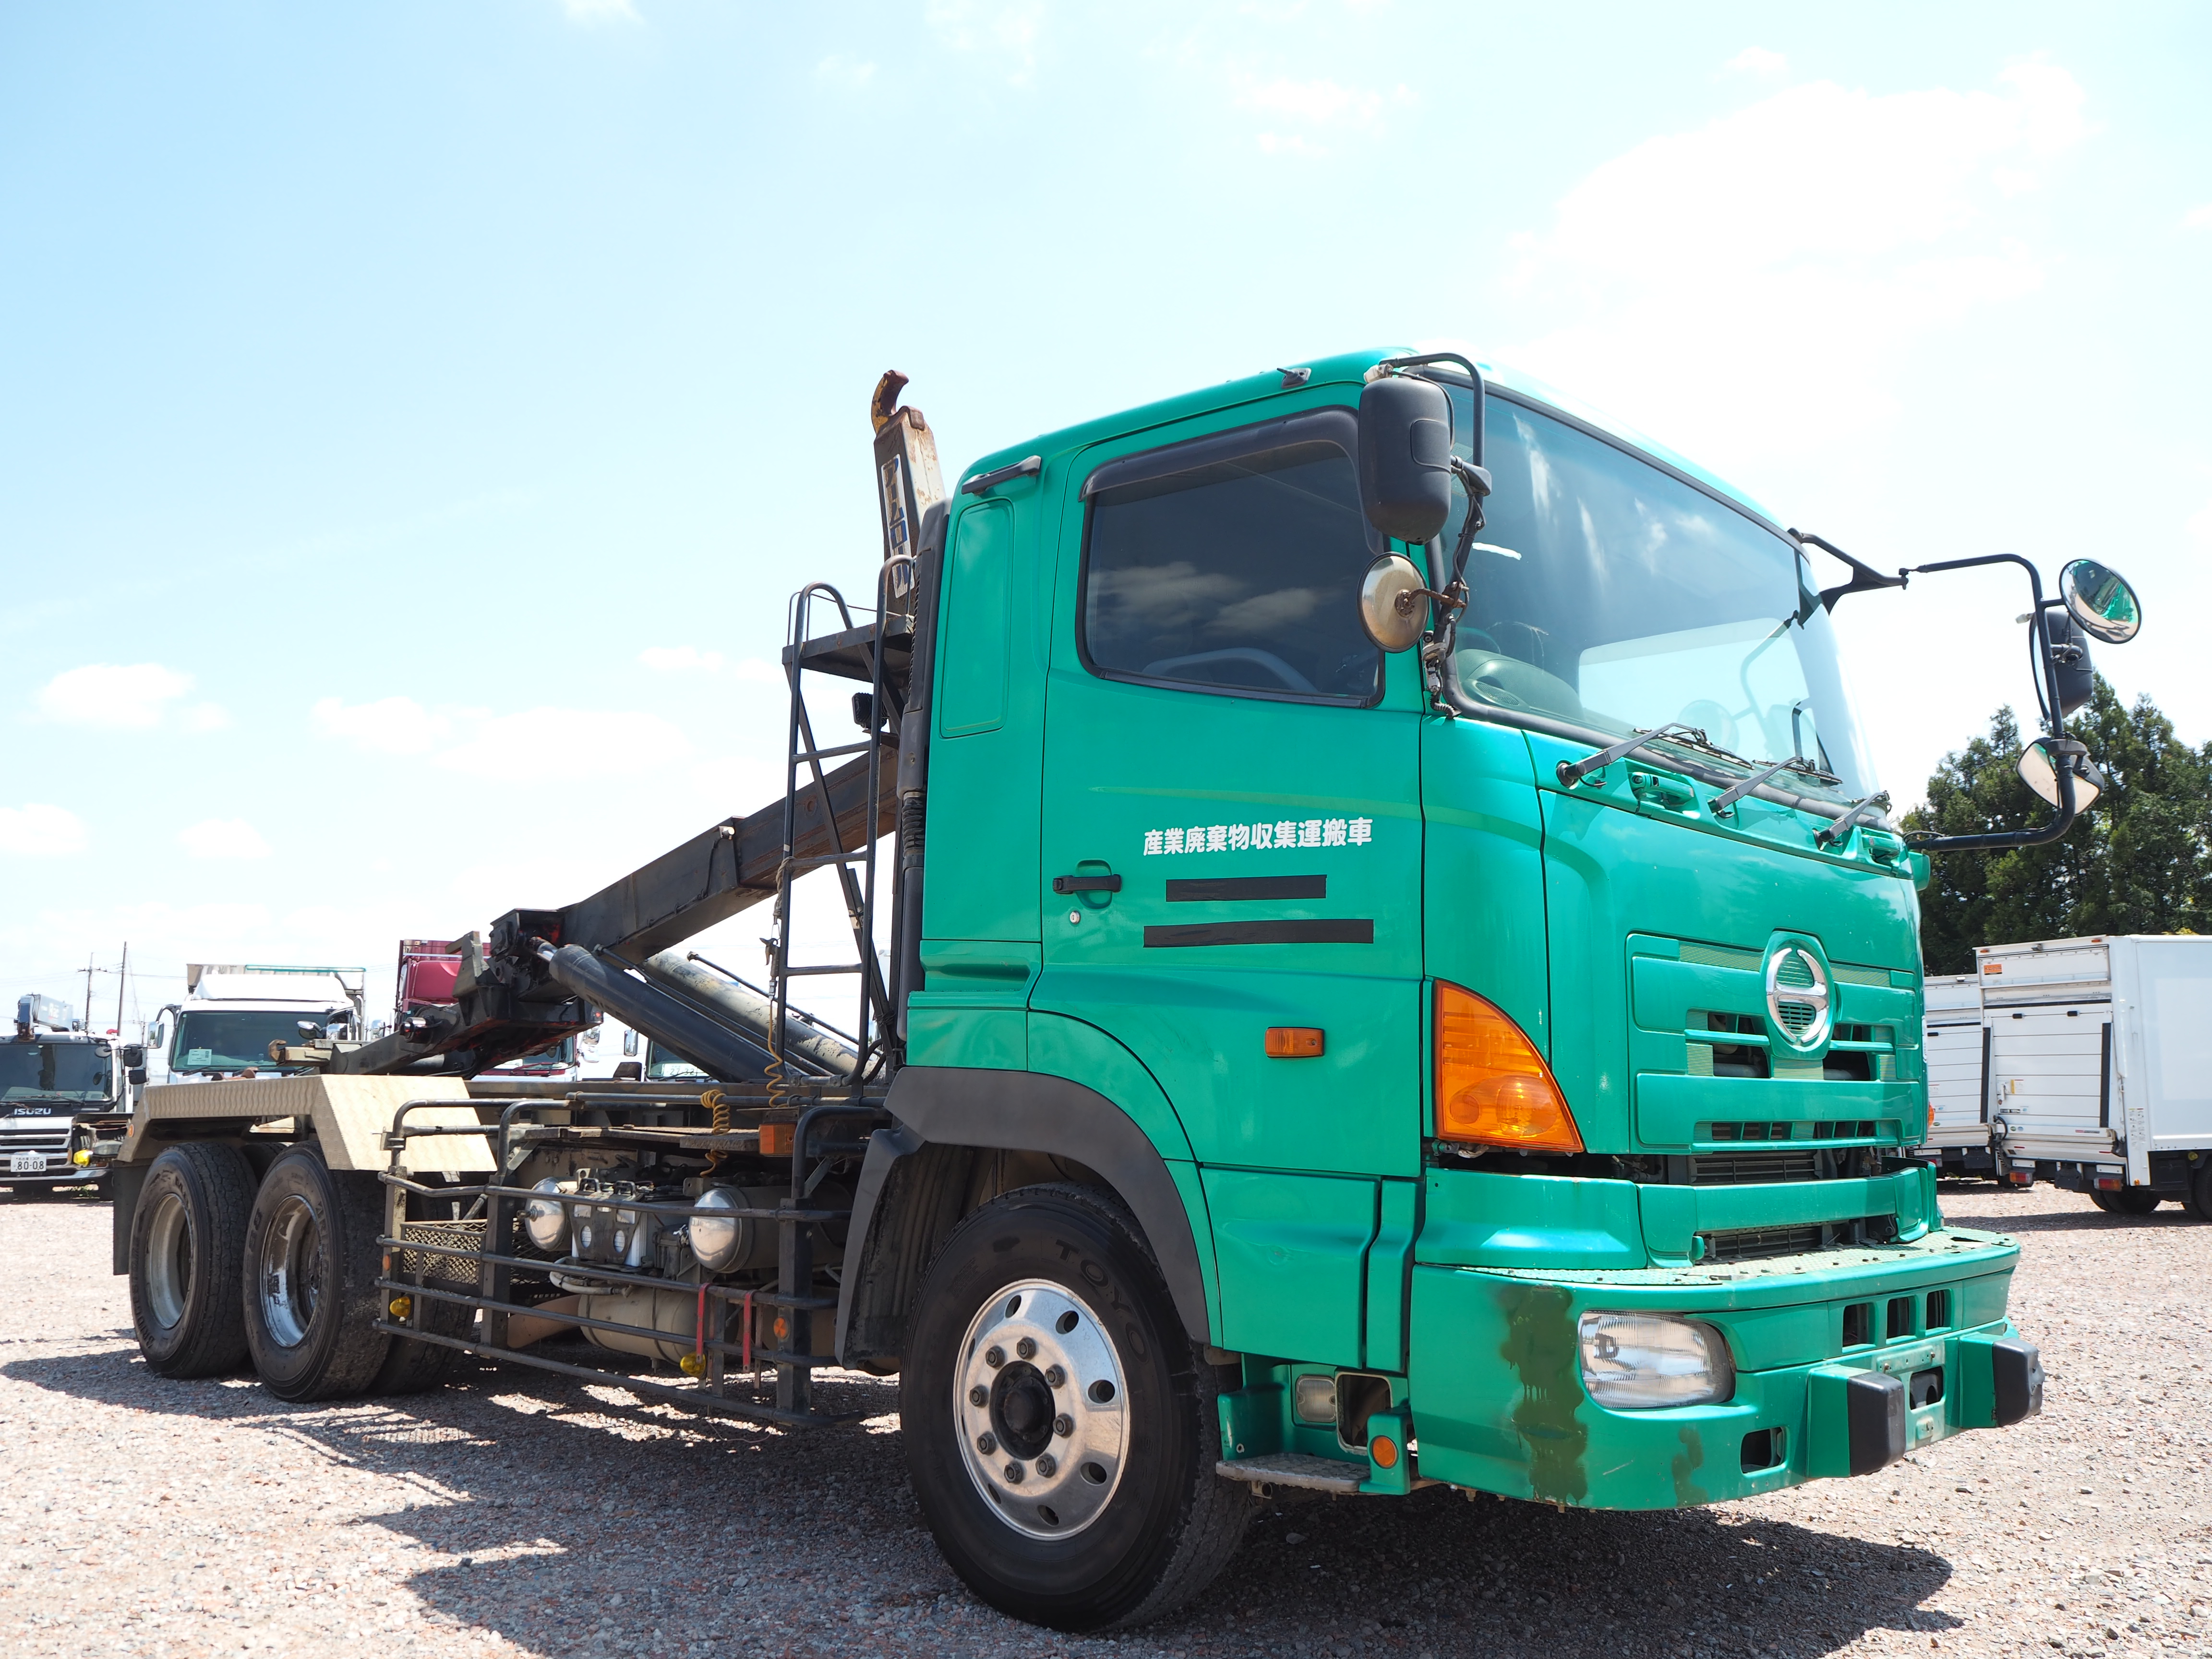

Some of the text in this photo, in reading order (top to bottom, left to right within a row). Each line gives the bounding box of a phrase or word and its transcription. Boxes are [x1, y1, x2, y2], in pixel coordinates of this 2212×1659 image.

[1143, 817, 1373, 856] 産業廃棄物収集運搬車
[17, 1161, 44, 1170] 80-08
[1055, 1239, 1150, 1364] TOYO
